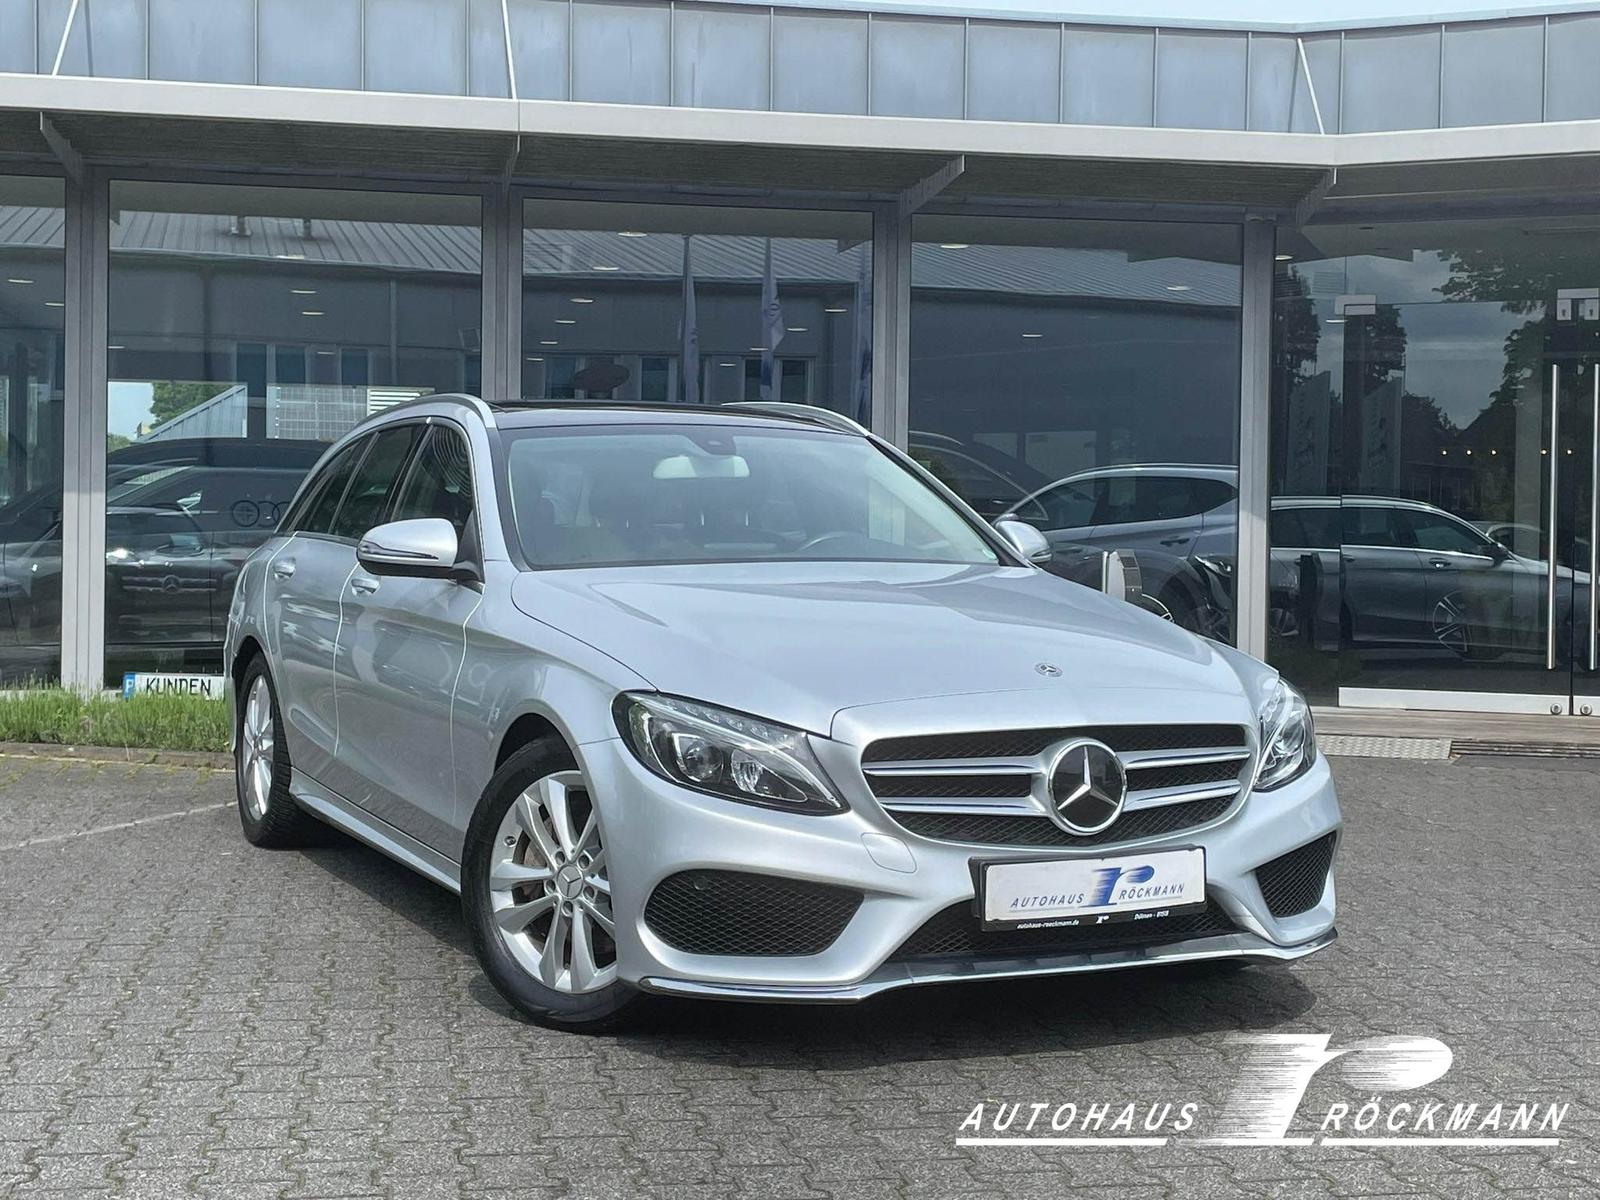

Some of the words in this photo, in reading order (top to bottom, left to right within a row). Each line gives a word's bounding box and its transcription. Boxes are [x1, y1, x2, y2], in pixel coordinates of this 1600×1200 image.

[146, 678, 211, 696] KUNDEN
[1010, 892, 1085, 908] AUTOHAUS
[1119, 883, 1185, 900] RÖCKMANN
